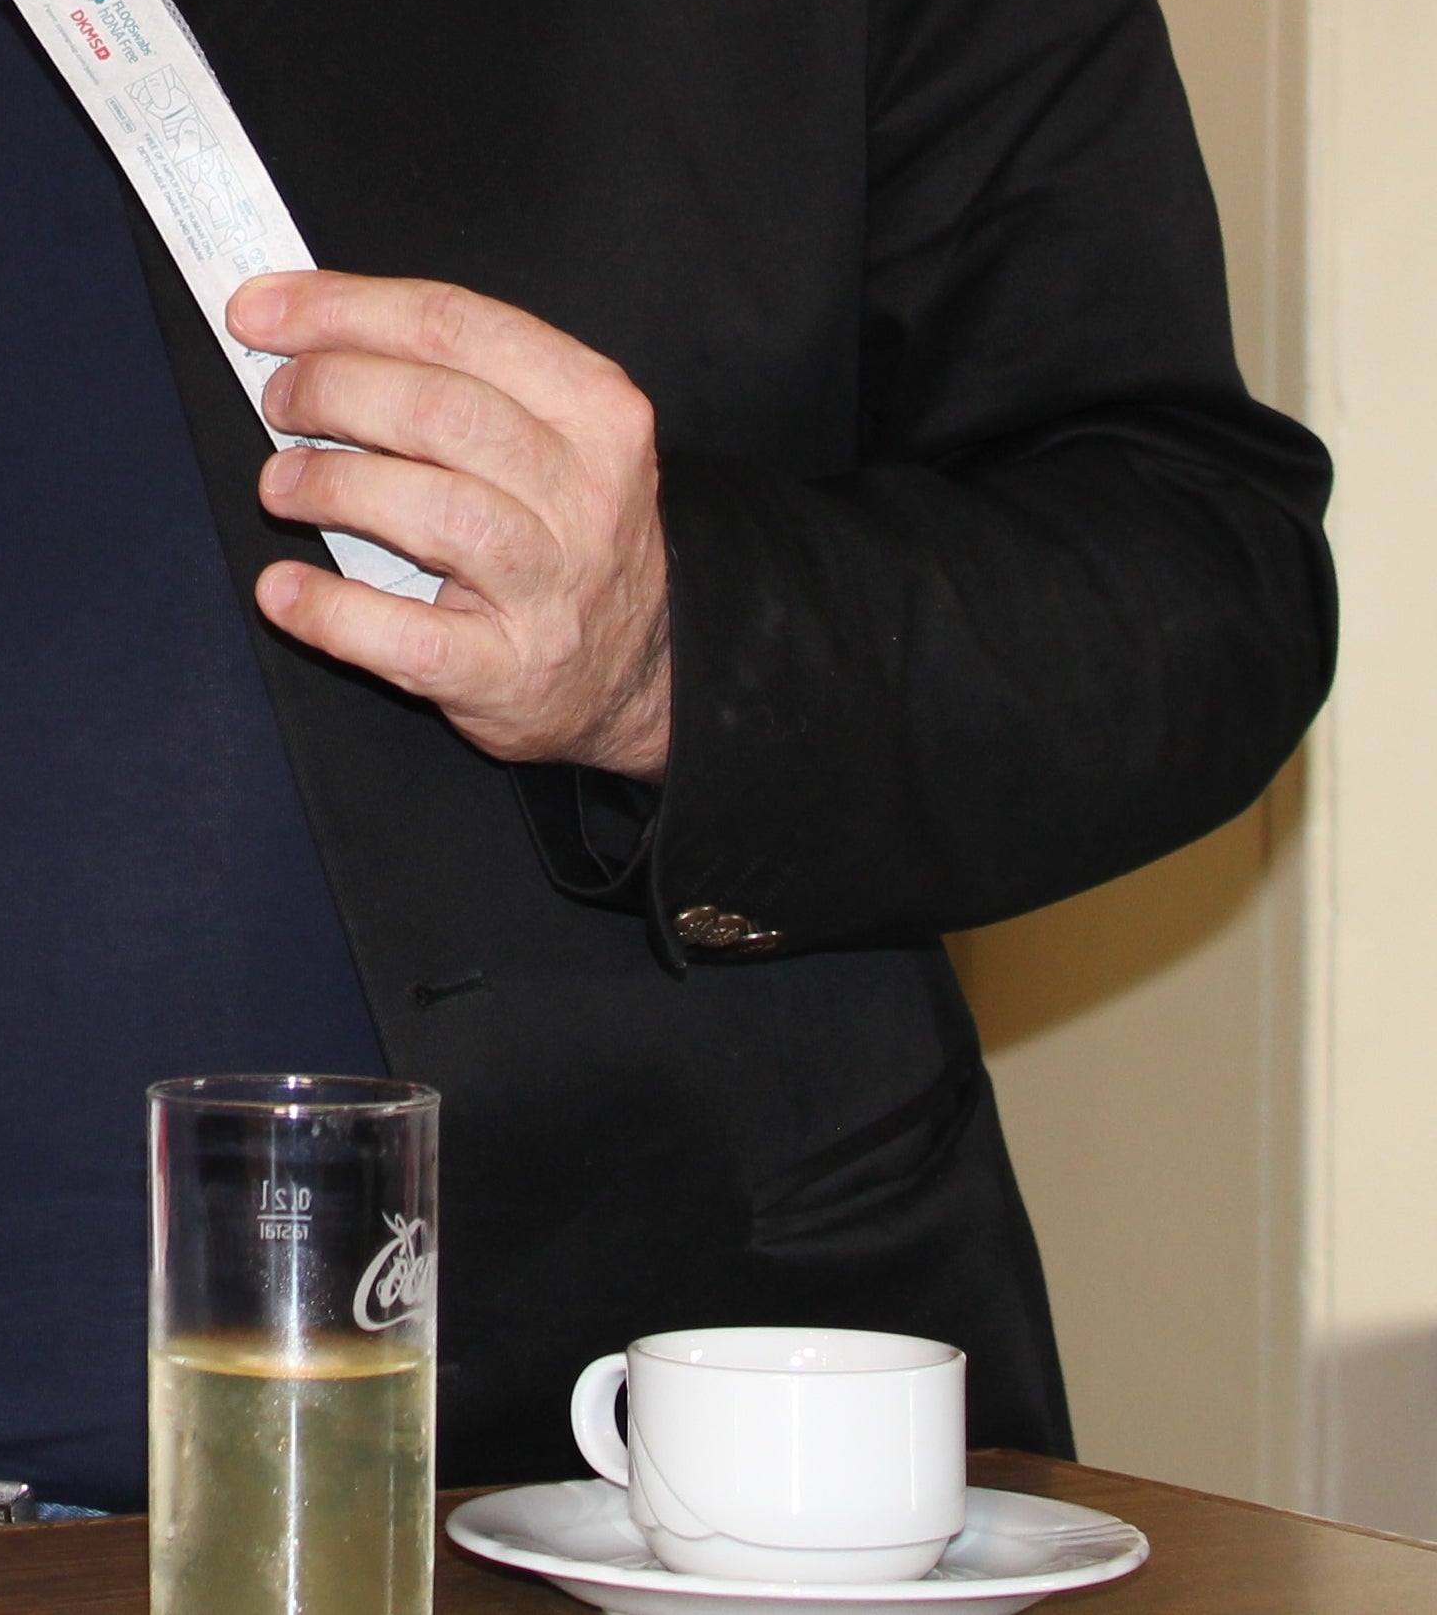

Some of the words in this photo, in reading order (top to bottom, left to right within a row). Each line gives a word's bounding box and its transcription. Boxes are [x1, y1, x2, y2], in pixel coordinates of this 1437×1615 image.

[70, 9, 103, 50] DKMS
[98, 8, 121, 43] hDNA
[119, 36, 140, 65] Free
[112, 0, 153, 57] FLOQSwabs
